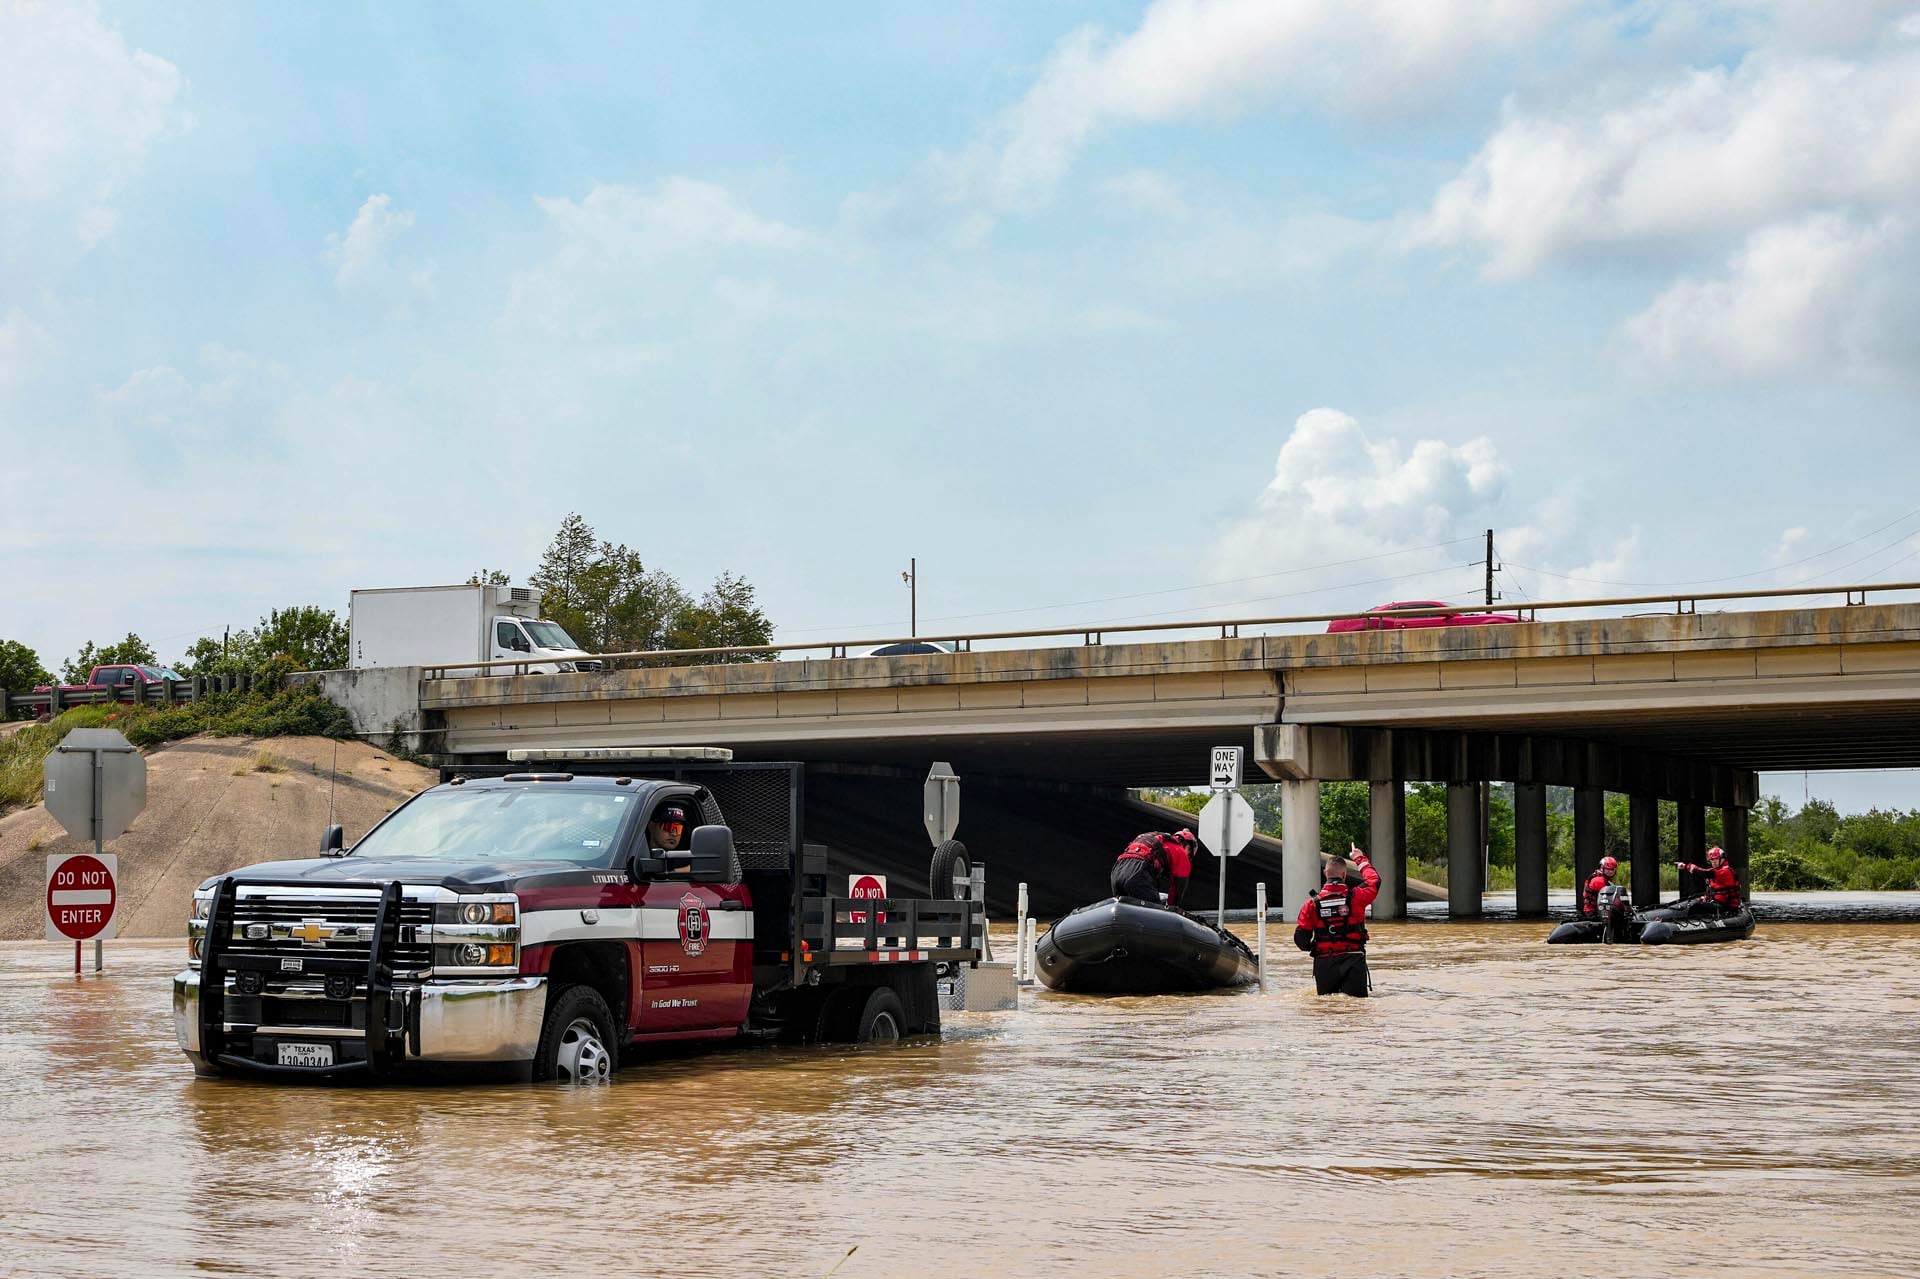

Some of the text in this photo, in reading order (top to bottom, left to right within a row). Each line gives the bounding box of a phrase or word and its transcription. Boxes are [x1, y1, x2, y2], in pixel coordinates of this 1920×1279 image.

[1215, 751, 1235, 761] ONE
[1214, 763, 1235, 772] WAY
[58, 871, 107, 885] DO NOT
[592, 874, 619, 883] UTILITY
[854, 887, 881, 898] DO NOT
[61, 909, 102, 924] ENTER
[688, 942, 701, 951] FIRE
[651, 998, 698, 1008] In God We Trust
[294, 1045, 316, 1053] TEXAS
